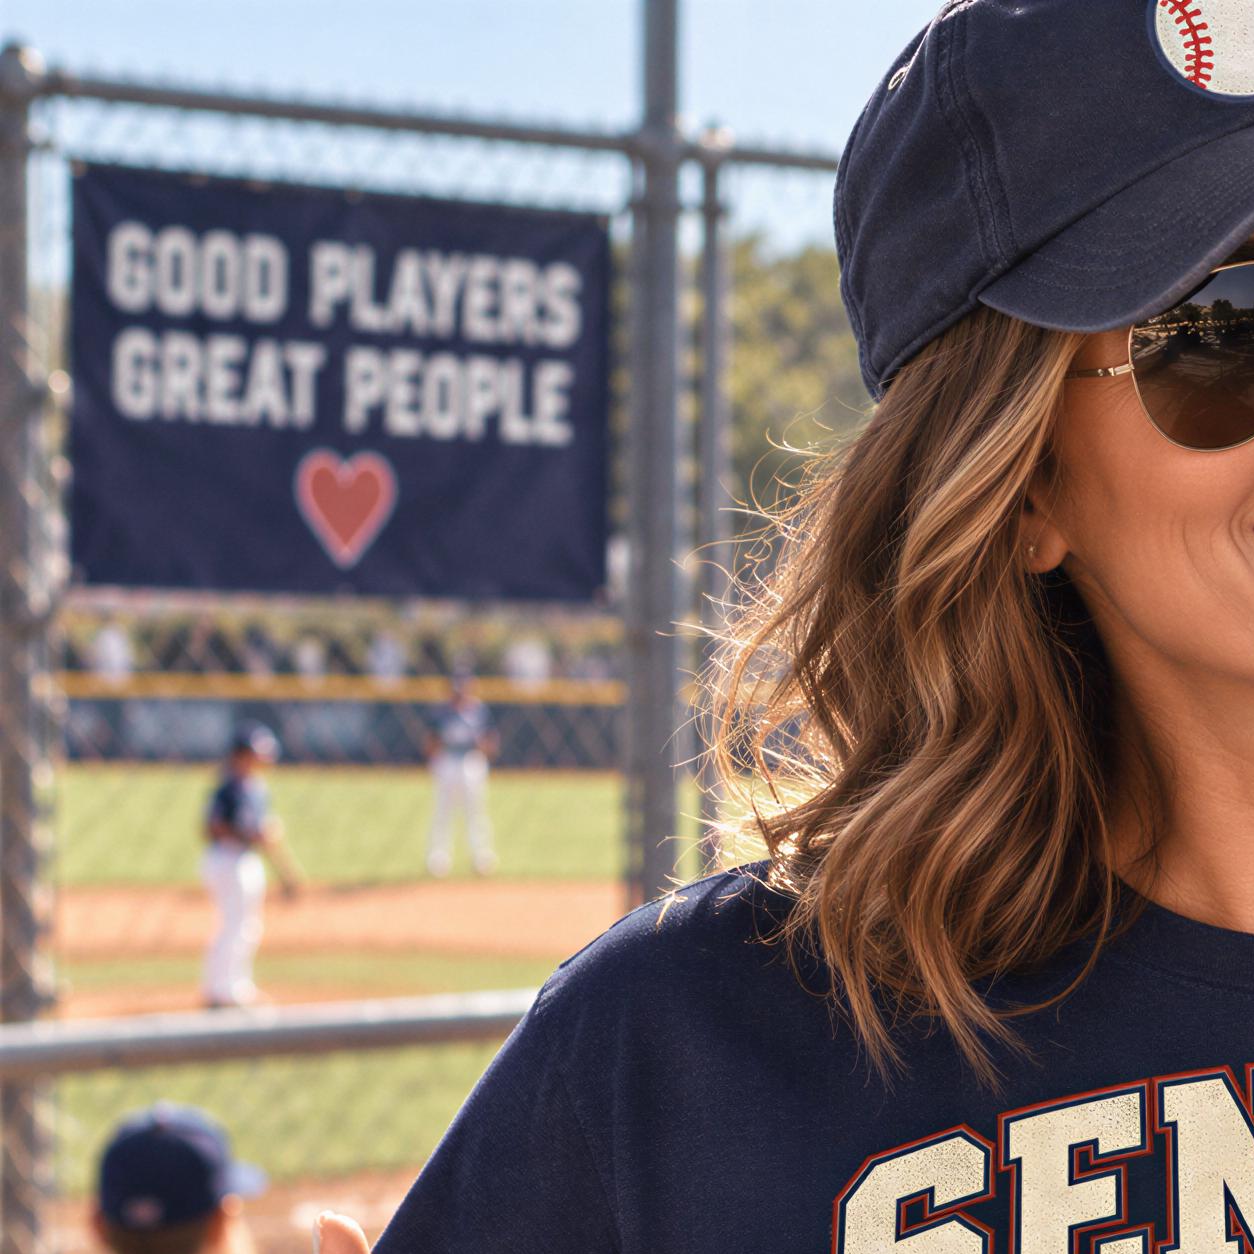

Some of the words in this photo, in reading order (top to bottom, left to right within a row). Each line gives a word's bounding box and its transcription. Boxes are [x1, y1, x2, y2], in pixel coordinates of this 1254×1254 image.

[107, 221, 288, 323] GOOD
[309, 240, 583, 348] PLAYERS
[112, 329, 326, 428] GREAT
[343, 345, 574, 447] PEOPLE
